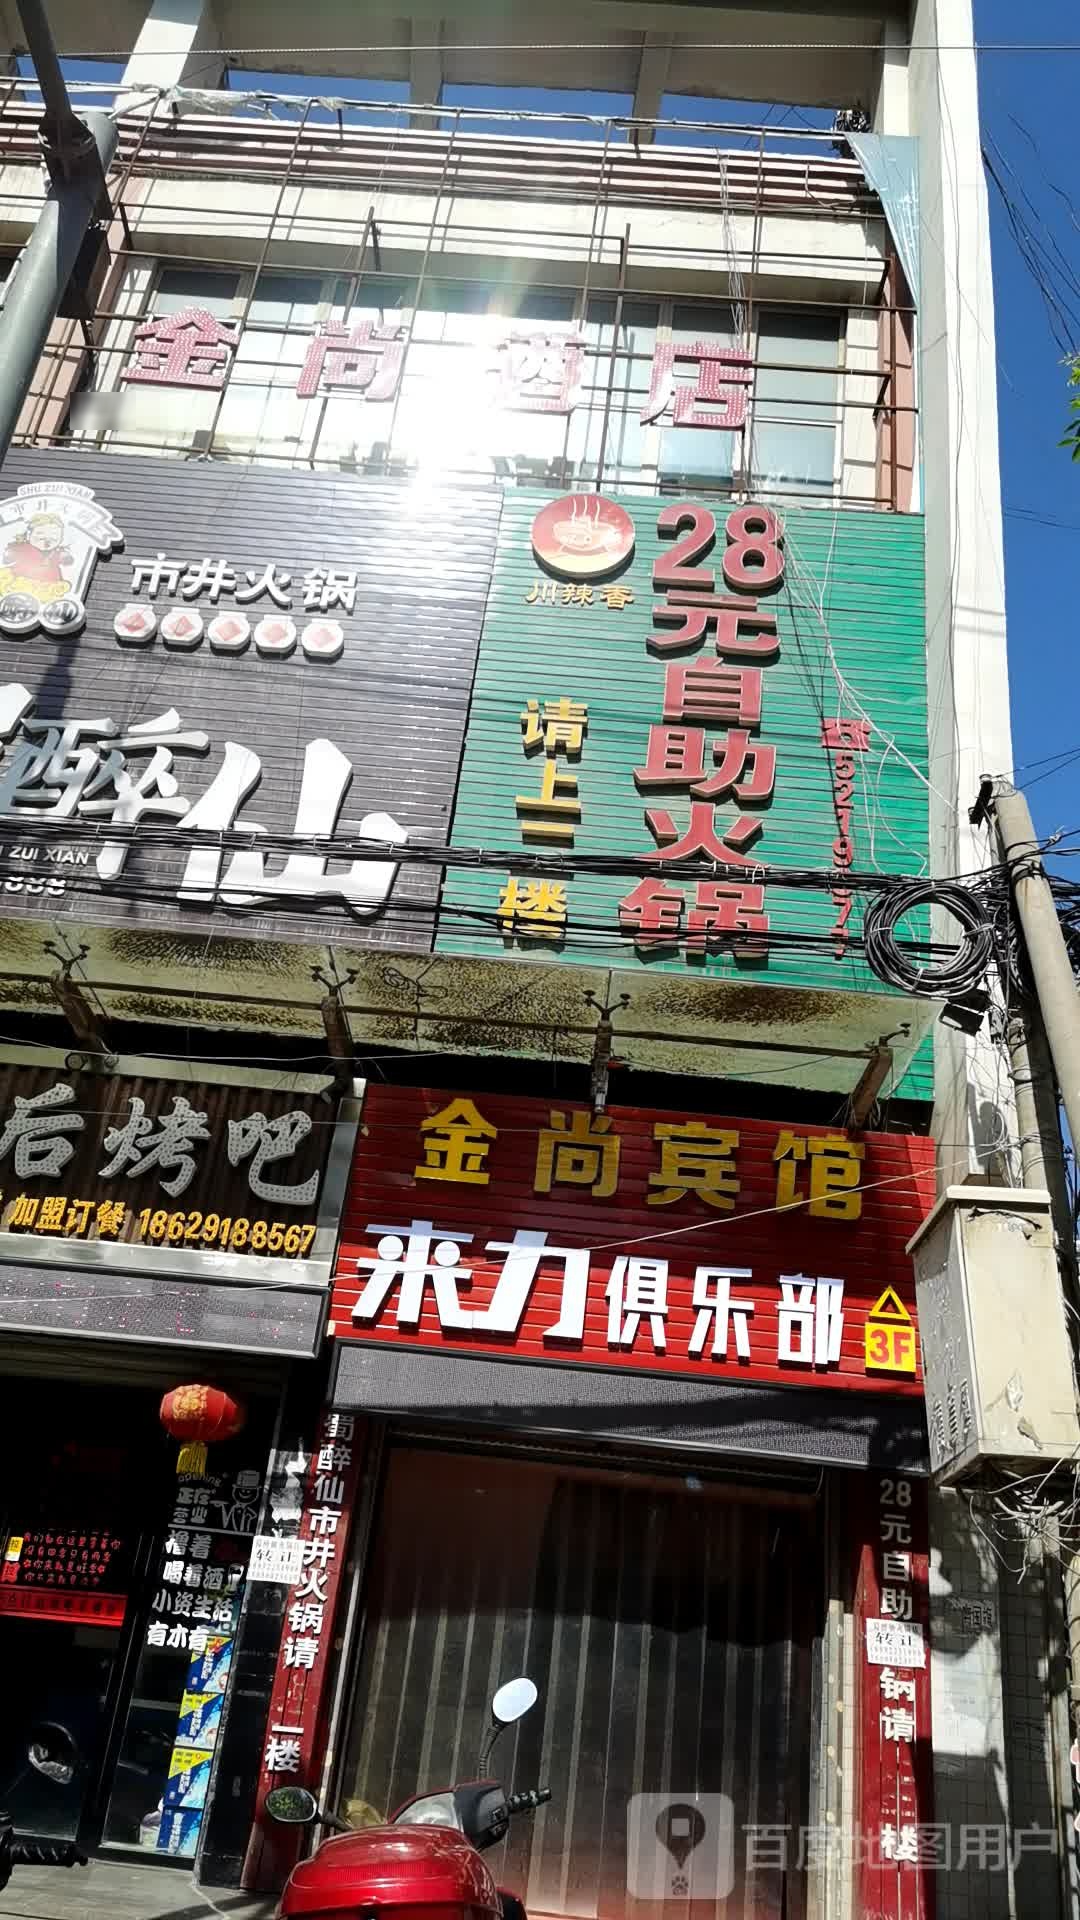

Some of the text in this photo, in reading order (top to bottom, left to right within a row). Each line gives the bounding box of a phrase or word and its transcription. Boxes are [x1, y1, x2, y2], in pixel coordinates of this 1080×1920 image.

[131, 553, 358, 615] 市井火锅
[525, 580, 634, 609] 川辣香
[618, 503, 786, 958] 28元自助火锅
[0, 683, 409, 916] 醉仙
[8, 845, 89, 865] ZUI XIAN
[0, 1082, 320, 1206] 后烤吧
[414, 1098, 866, 1220] 金尚宾馆
[8, 1193, 318, 1253] 加盟订餐 18629188567
[351, 1219, 845, 1366] 来力俱乐部
[869, 1329, 912, 1365] 3F
[162, 1559, 225, 1591] 喝着酒
[151, 1588, 234, 1623] 小资生活
[146, 1620, 210, 1656] 有木有
